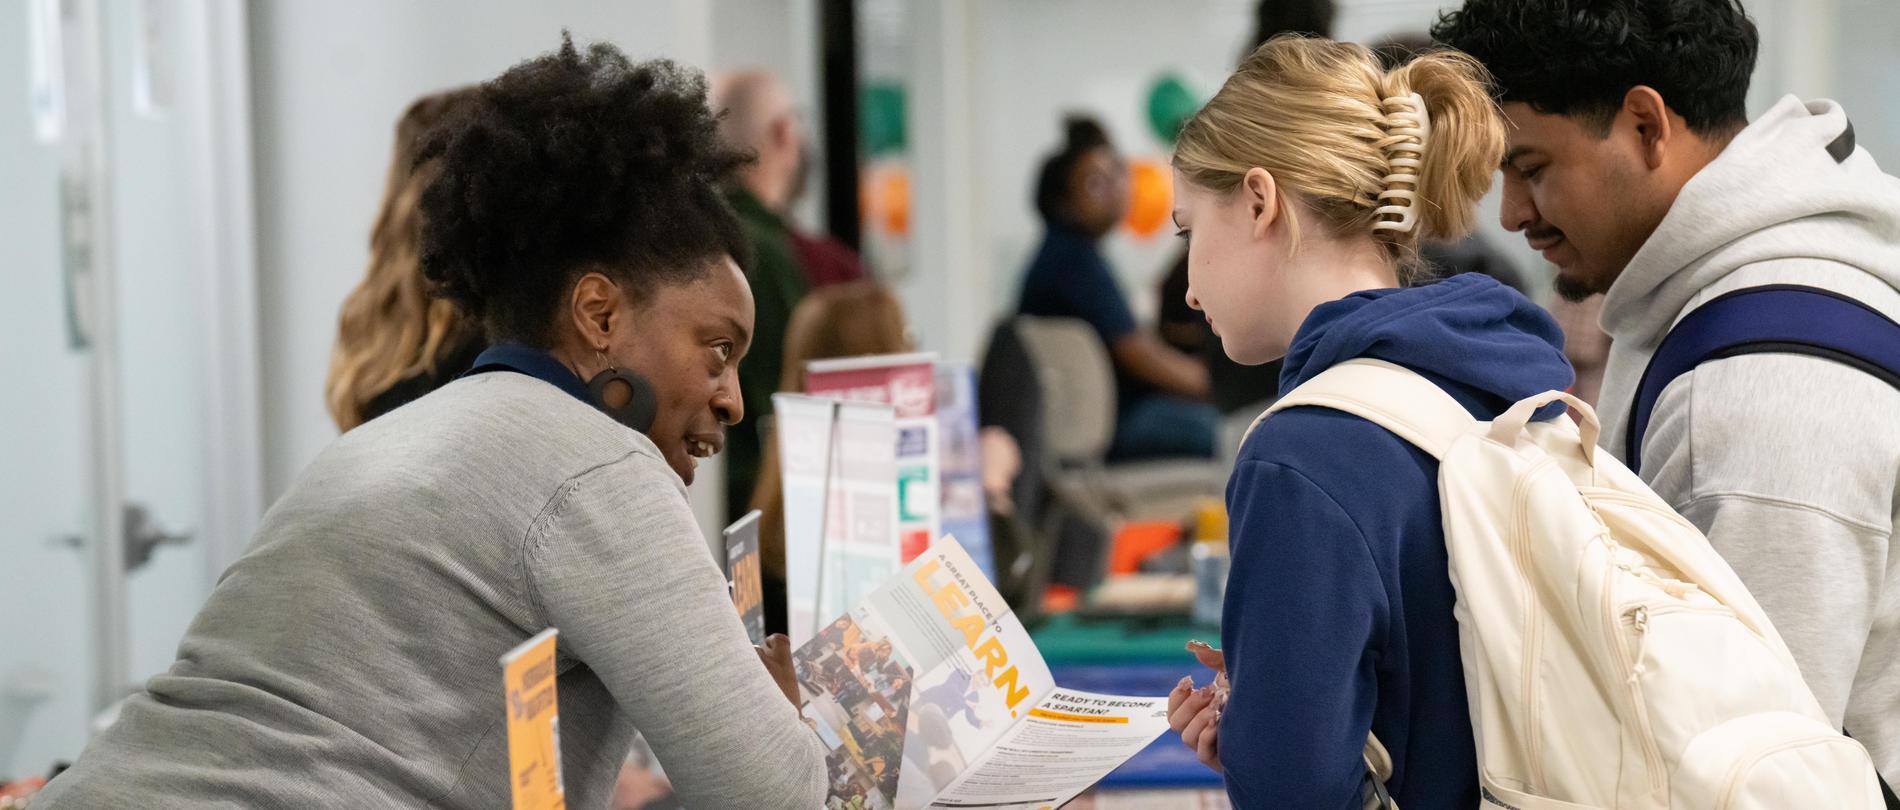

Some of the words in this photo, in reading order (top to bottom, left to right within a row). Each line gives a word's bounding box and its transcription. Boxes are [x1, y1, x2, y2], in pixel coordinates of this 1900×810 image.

[938, 554, 946, 562] A
[945, 561, 971, 591] GREAT
[968, 590, 993, 621] PLACE
[991, 619, 1002, 633] TO
[913, 559, 1030, 719] LEARN.
[1051, 693, 1091, 705] READY
[1091, 699, 1106, 707] TO
[1107, 700, 1155, 709] BECOME
[1052, 703, 1110, 716] SPARTAN?
